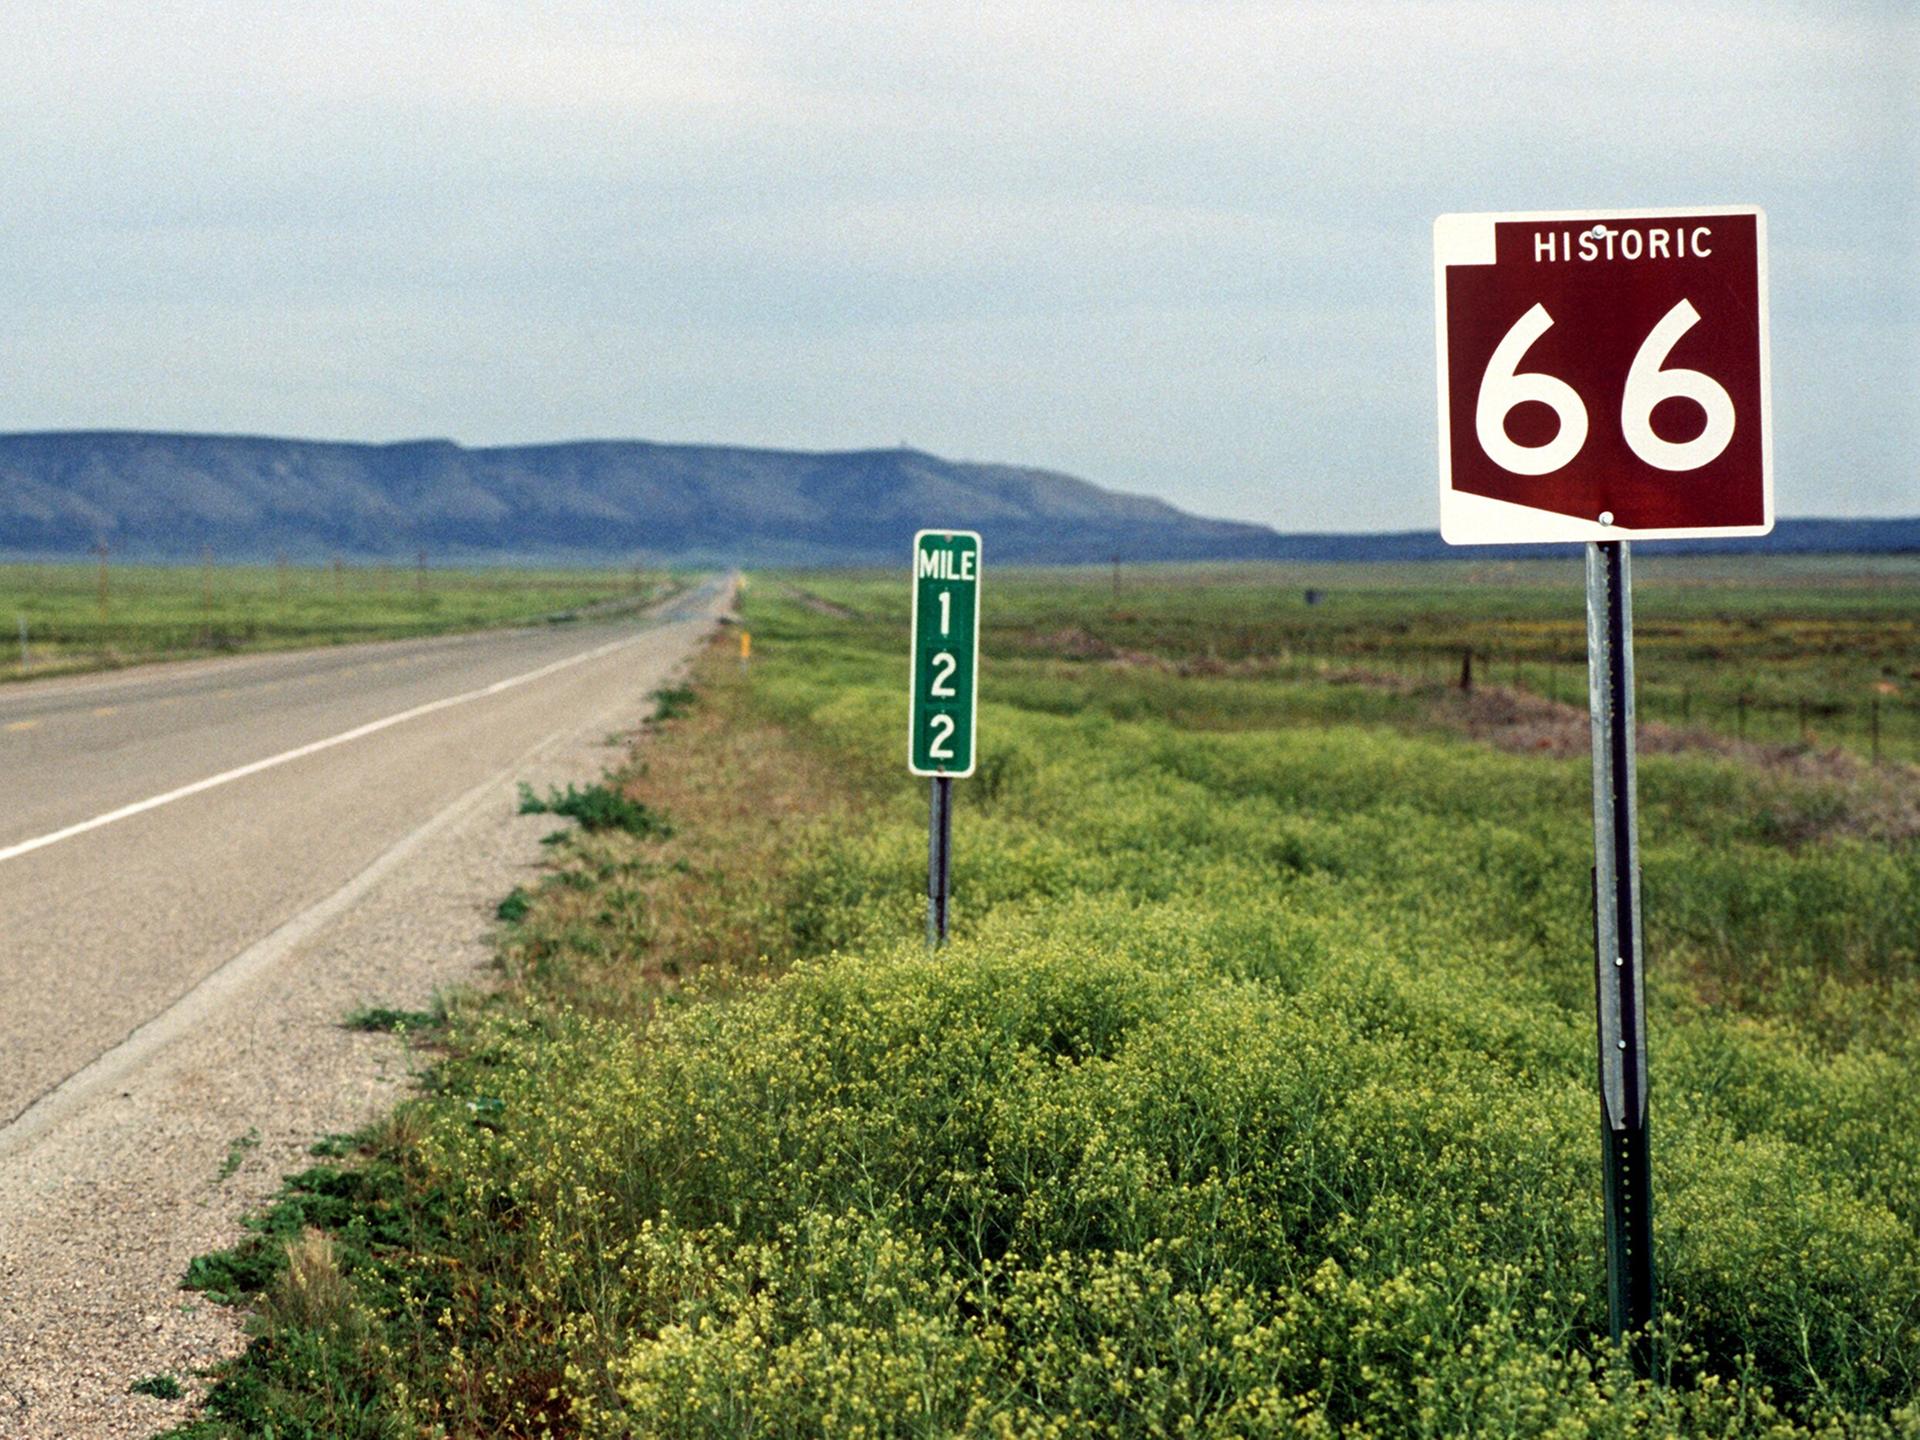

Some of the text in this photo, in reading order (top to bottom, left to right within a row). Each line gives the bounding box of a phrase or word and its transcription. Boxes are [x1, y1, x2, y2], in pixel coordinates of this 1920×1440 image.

[1534, 226, 1713, 263] HISTORIC
[1475, 298, 1736, 476] 66
[918, 549, 976, 581] MILE
